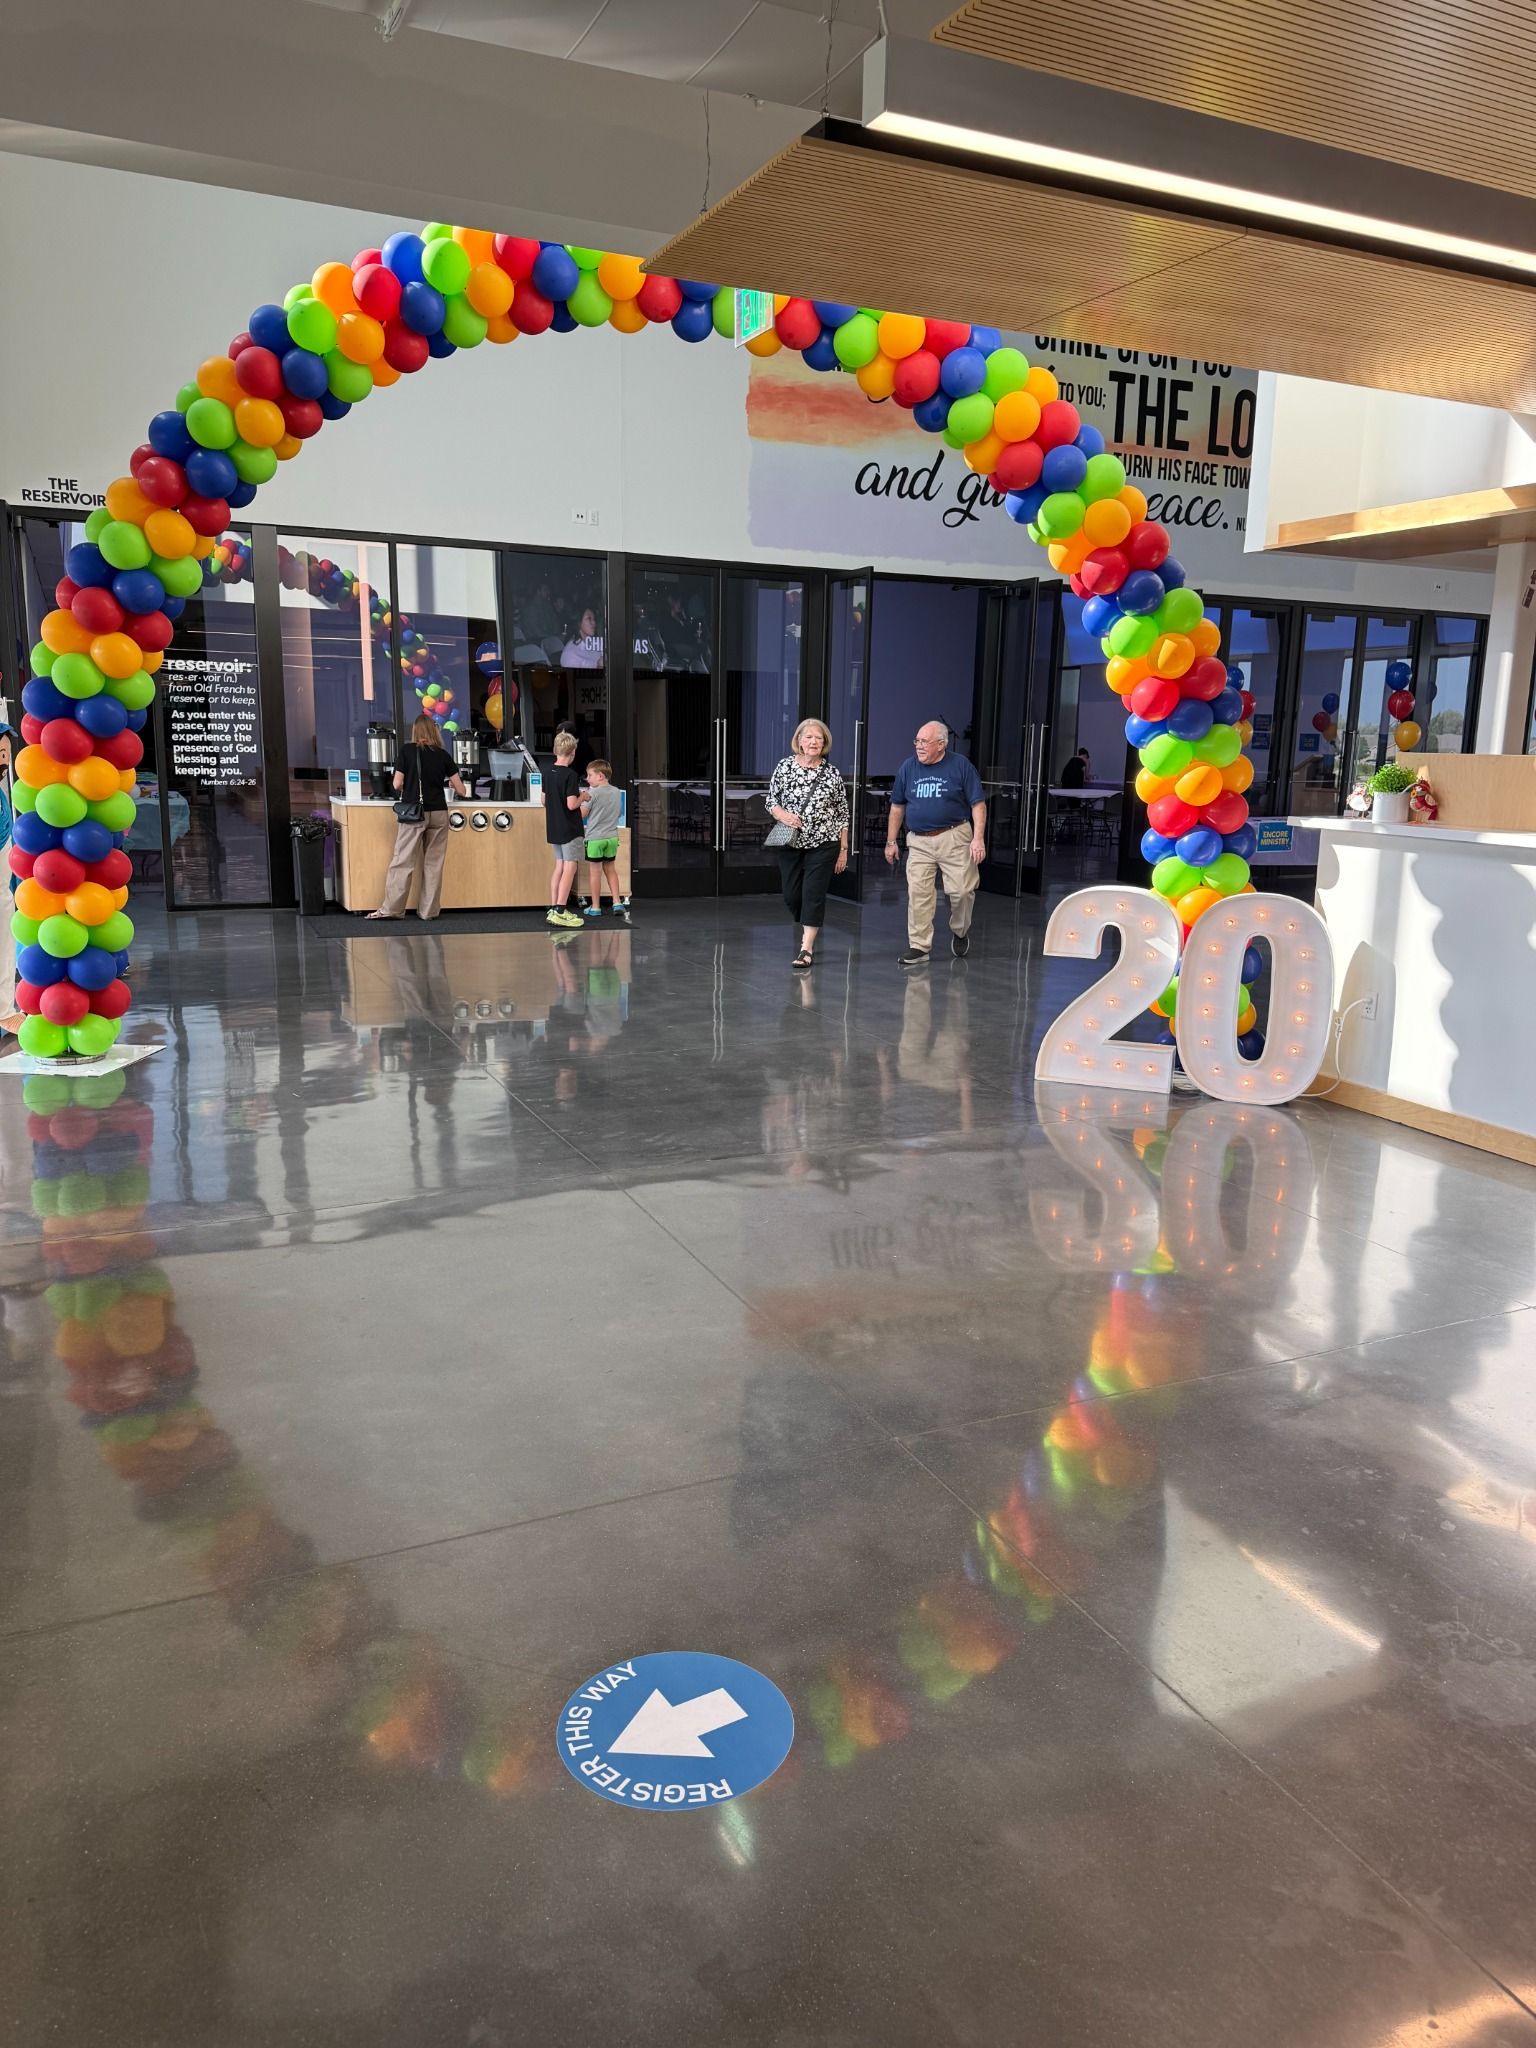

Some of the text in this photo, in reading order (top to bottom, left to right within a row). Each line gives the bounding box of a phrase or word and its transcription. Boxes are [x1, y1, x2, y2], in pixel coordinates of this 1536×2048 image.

[1058, 381, 1106, 410] TO YOU;
[1108, 370, 1258, 459] THE LO
[1157, 457, 1182, 482] HIS
[1184, 460, 1219, 486] FACE
[1223, 464, 1251, 490] TOW
[47, 477, 79, 491] THE
[854, 449, 945, 501] and
[1145, 493, 1229, 530] eace.
[21, 488, 107, 506] RESERVOIR
[167, 658, 252, 673] reservoir:
[168, 683, 256, 694] from Old French to
[169, 695, 205, 703] reserve
[220, 696, 230, 704] to
[171, 710, 256, 721] As you enter this
[171, 722, 252, 732] space, may you
[171, 732, 252, 743] experience the
[173, 743, 257, 754] presence of God
[173, 754, 239, 766] blessing and
[174, 765, 243, 778] keeping you.
[916, 782, 943, 798] HOPE
[1262, 830, 1289, 838] ENCORE
[1034, 885, 1334, 1105] 20
[564, 1661, 734, 1803] REGISTER THIS WAY
